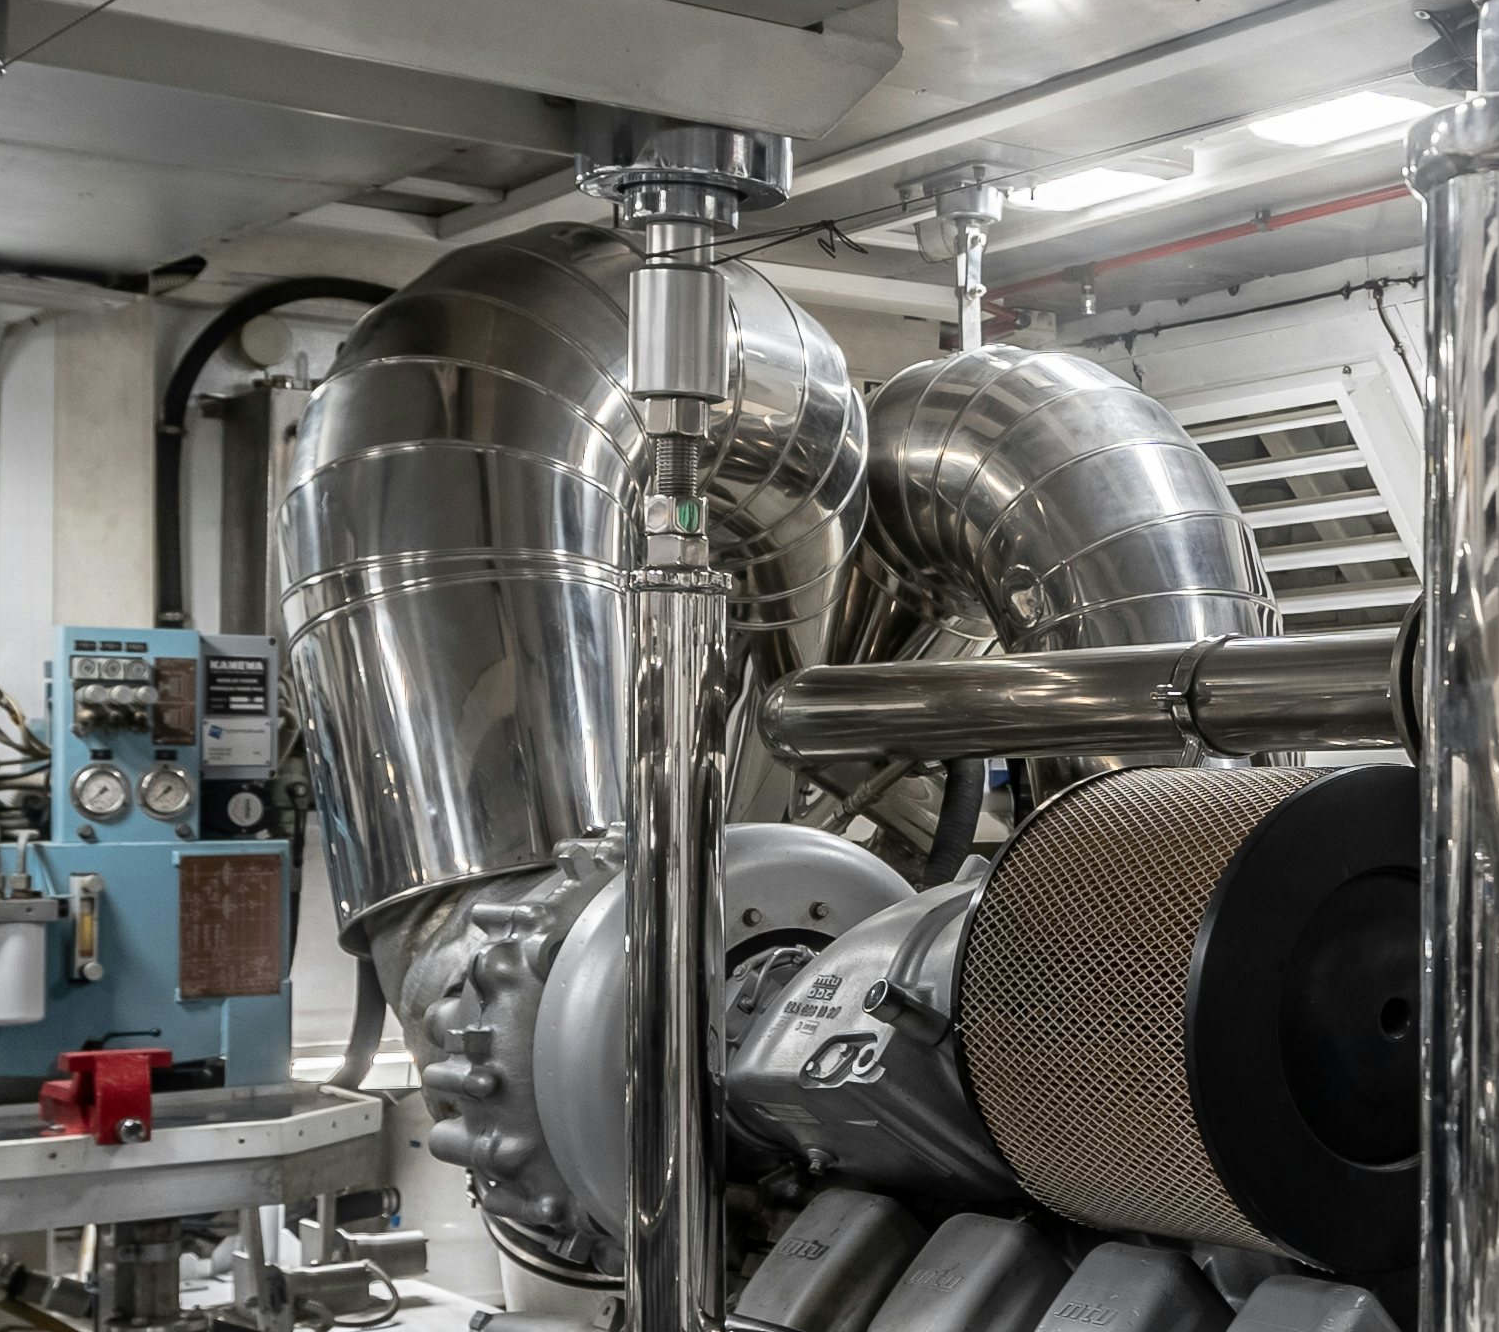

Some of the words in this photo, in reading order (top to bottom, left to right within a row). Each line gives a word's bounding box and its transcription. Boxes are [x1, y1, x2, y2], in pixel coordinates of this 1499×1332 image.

[814, 974, 843, 987] mtu
[781, 1239, 830, 1261] mtu
[1053, 1301, 1120, 1327] mtu
